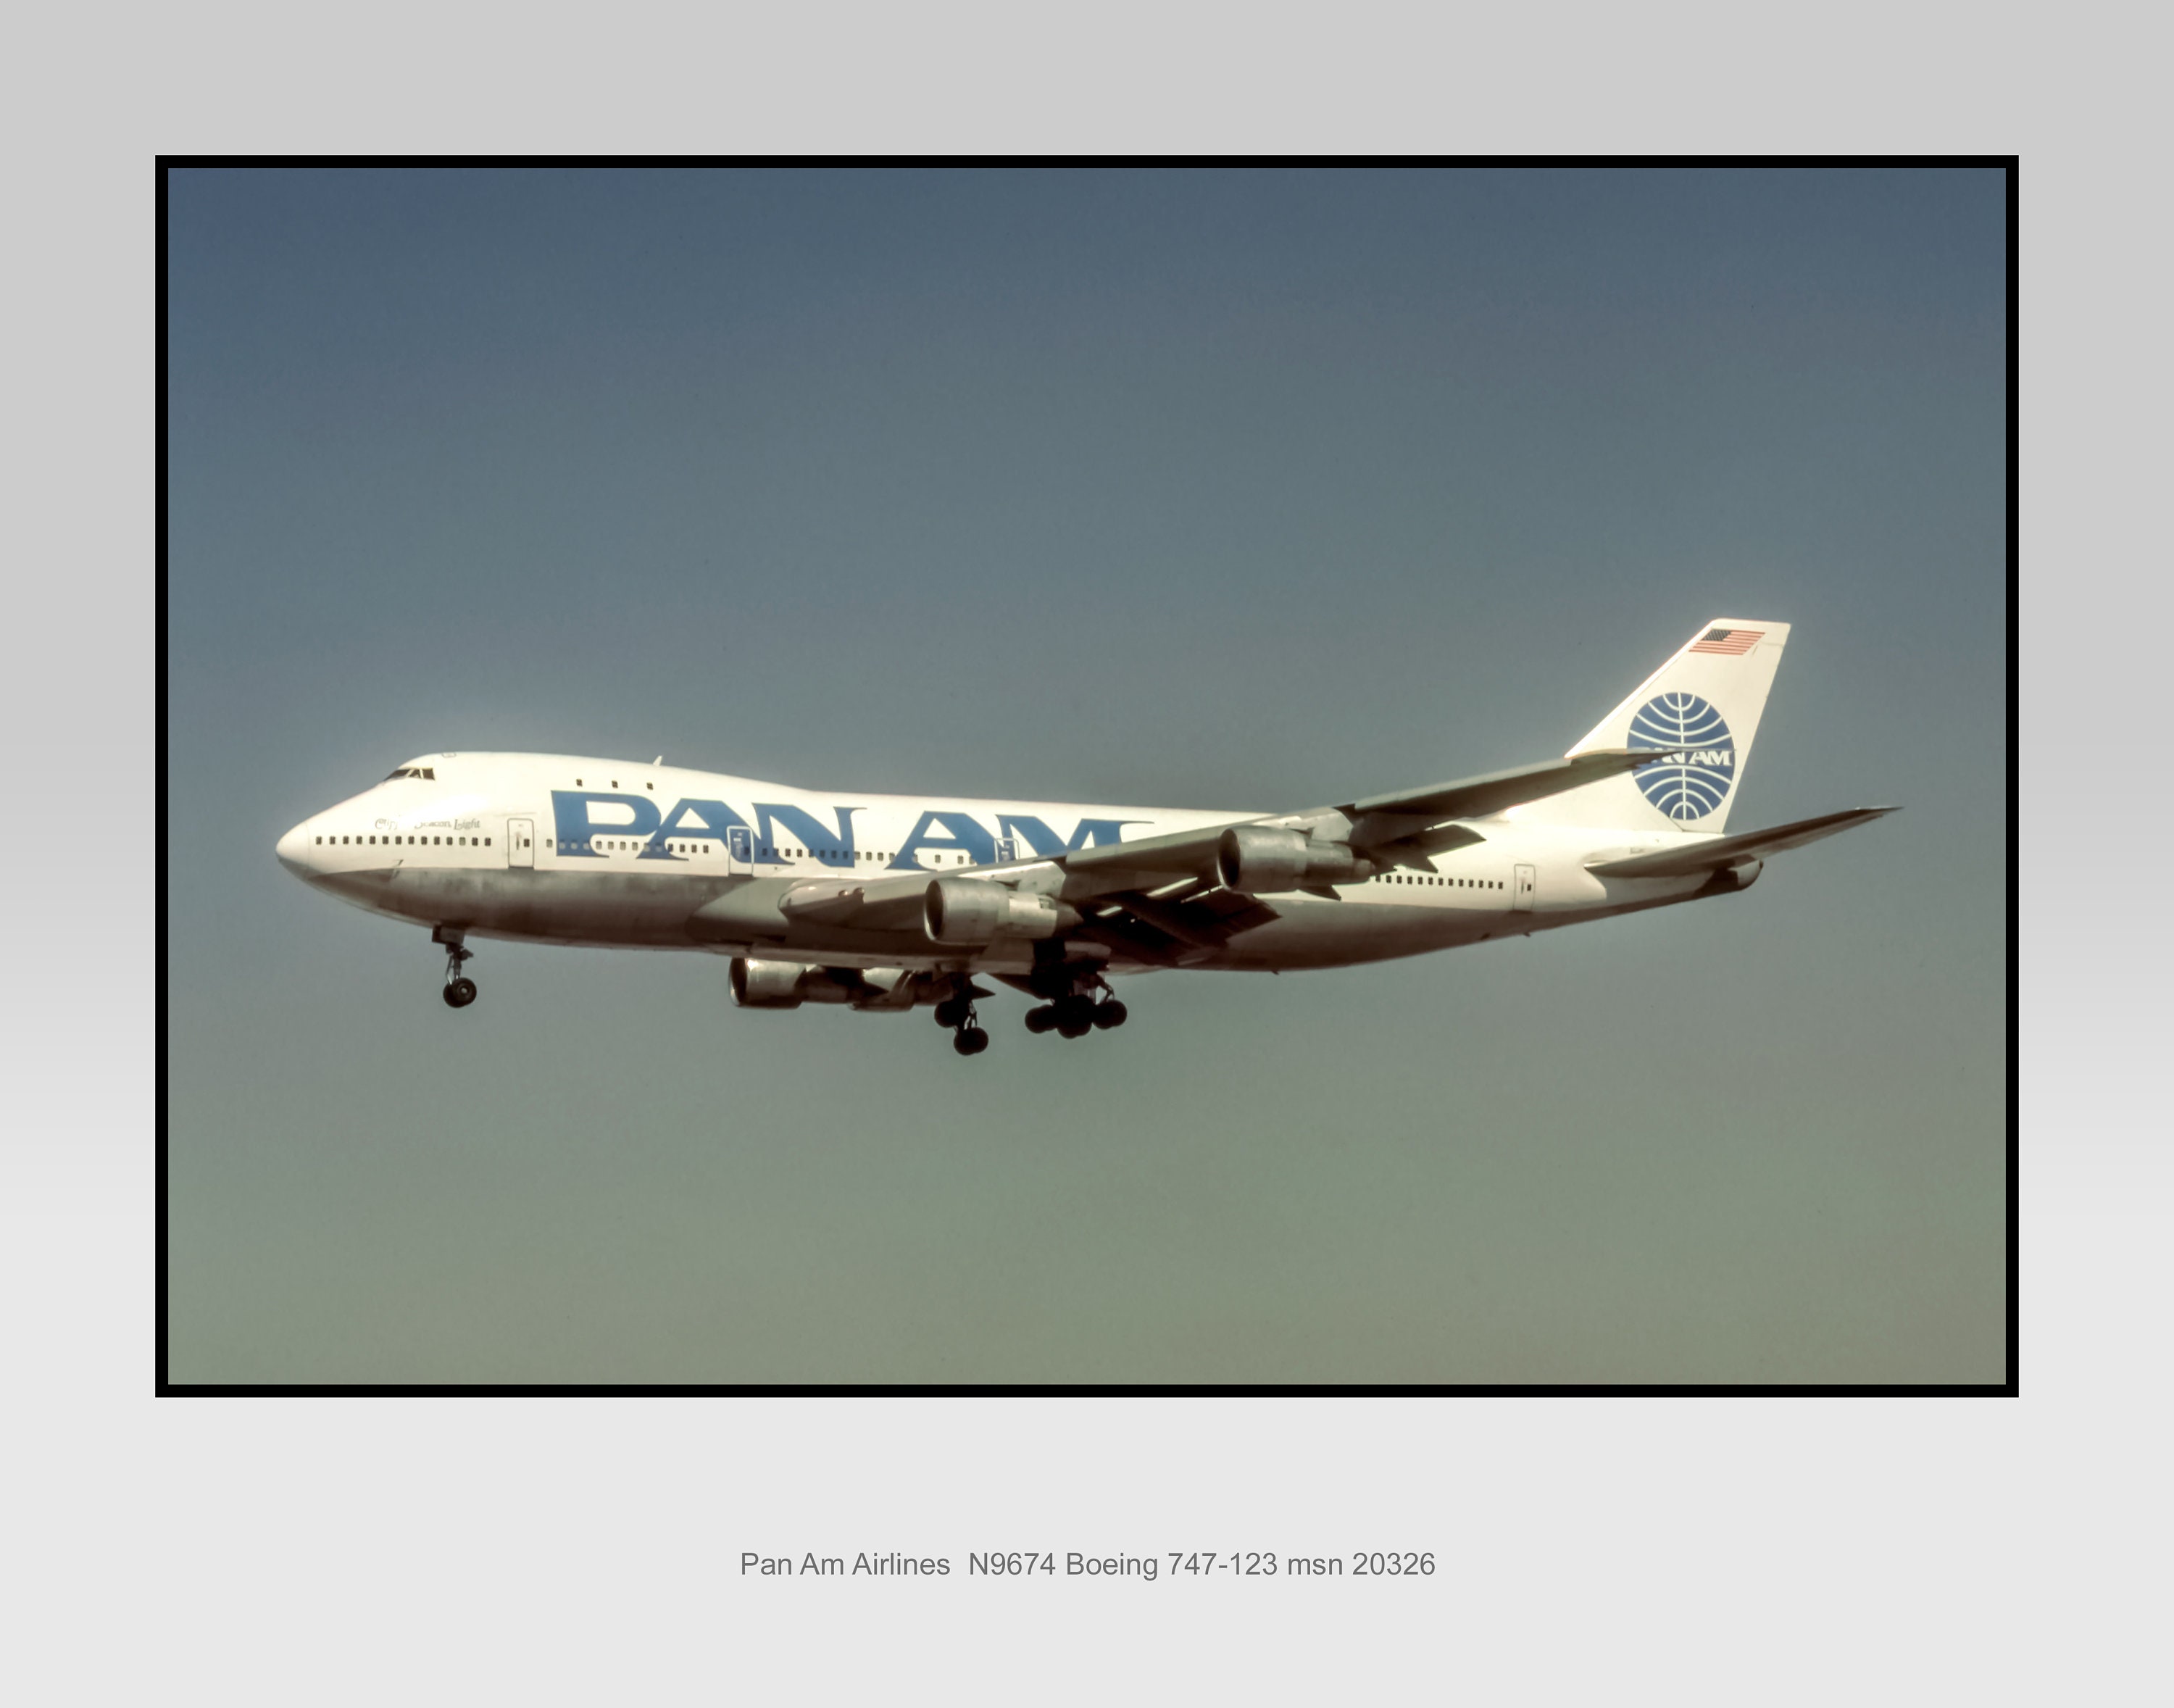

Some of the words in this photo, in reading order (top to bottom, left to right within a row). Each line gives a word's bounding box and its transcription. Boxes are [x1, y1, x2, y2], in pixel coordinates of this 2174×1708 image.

[1688, 749, 1732, 766] AM
[550, 790, 868, 868] PAN
[884, 810, 1154, 872] AM
